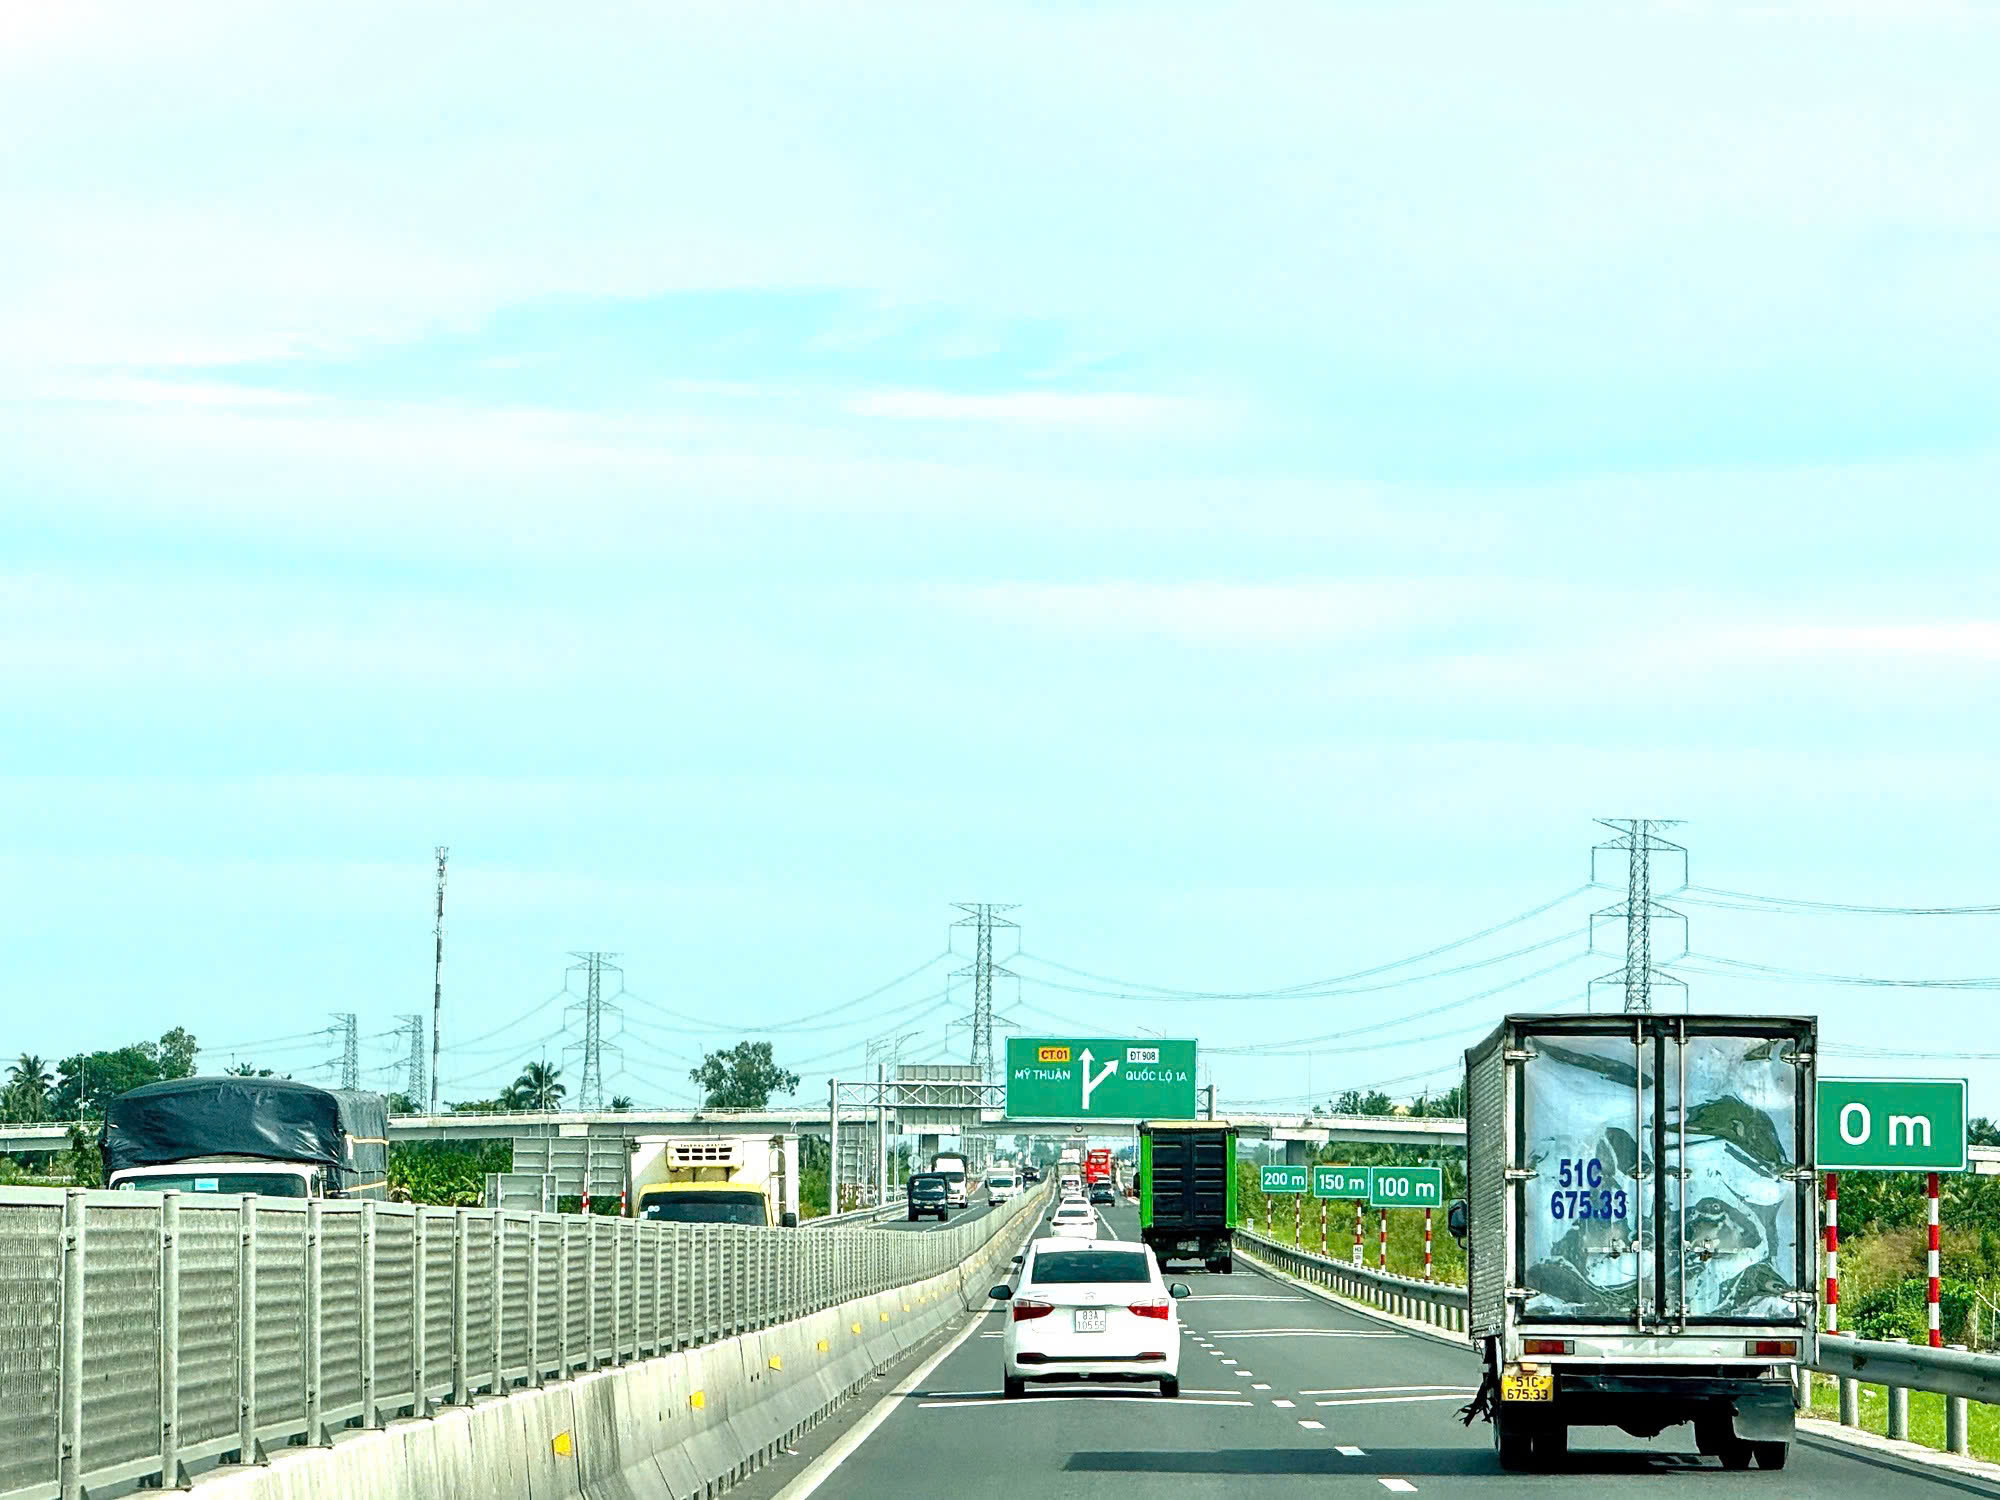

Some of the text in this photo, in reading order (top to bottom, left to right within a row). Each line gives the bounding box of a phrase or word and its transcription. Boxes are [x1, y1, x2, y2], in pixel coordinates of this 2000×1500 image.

[1041, 1050, 1068, 1060] CT.01
[1033, 1067, 1071, 1082] THUẬN
[1125, 1066, 1188, 1083] QUỐC LỘ 1A
[1840, 1102, 1931, 1147] 0 m
[1264, 1172, 1305, 1185] 200 m
[1559, 1158, 1602, 1188] 51C
[1319, 1174, 1364, 1191] 150 m
[1377, 1177, 1435, 1197] 100 m
[1551, 1190, 1627, 1219] 675.33
[1516, 1376, 1539, 1387] 51C
